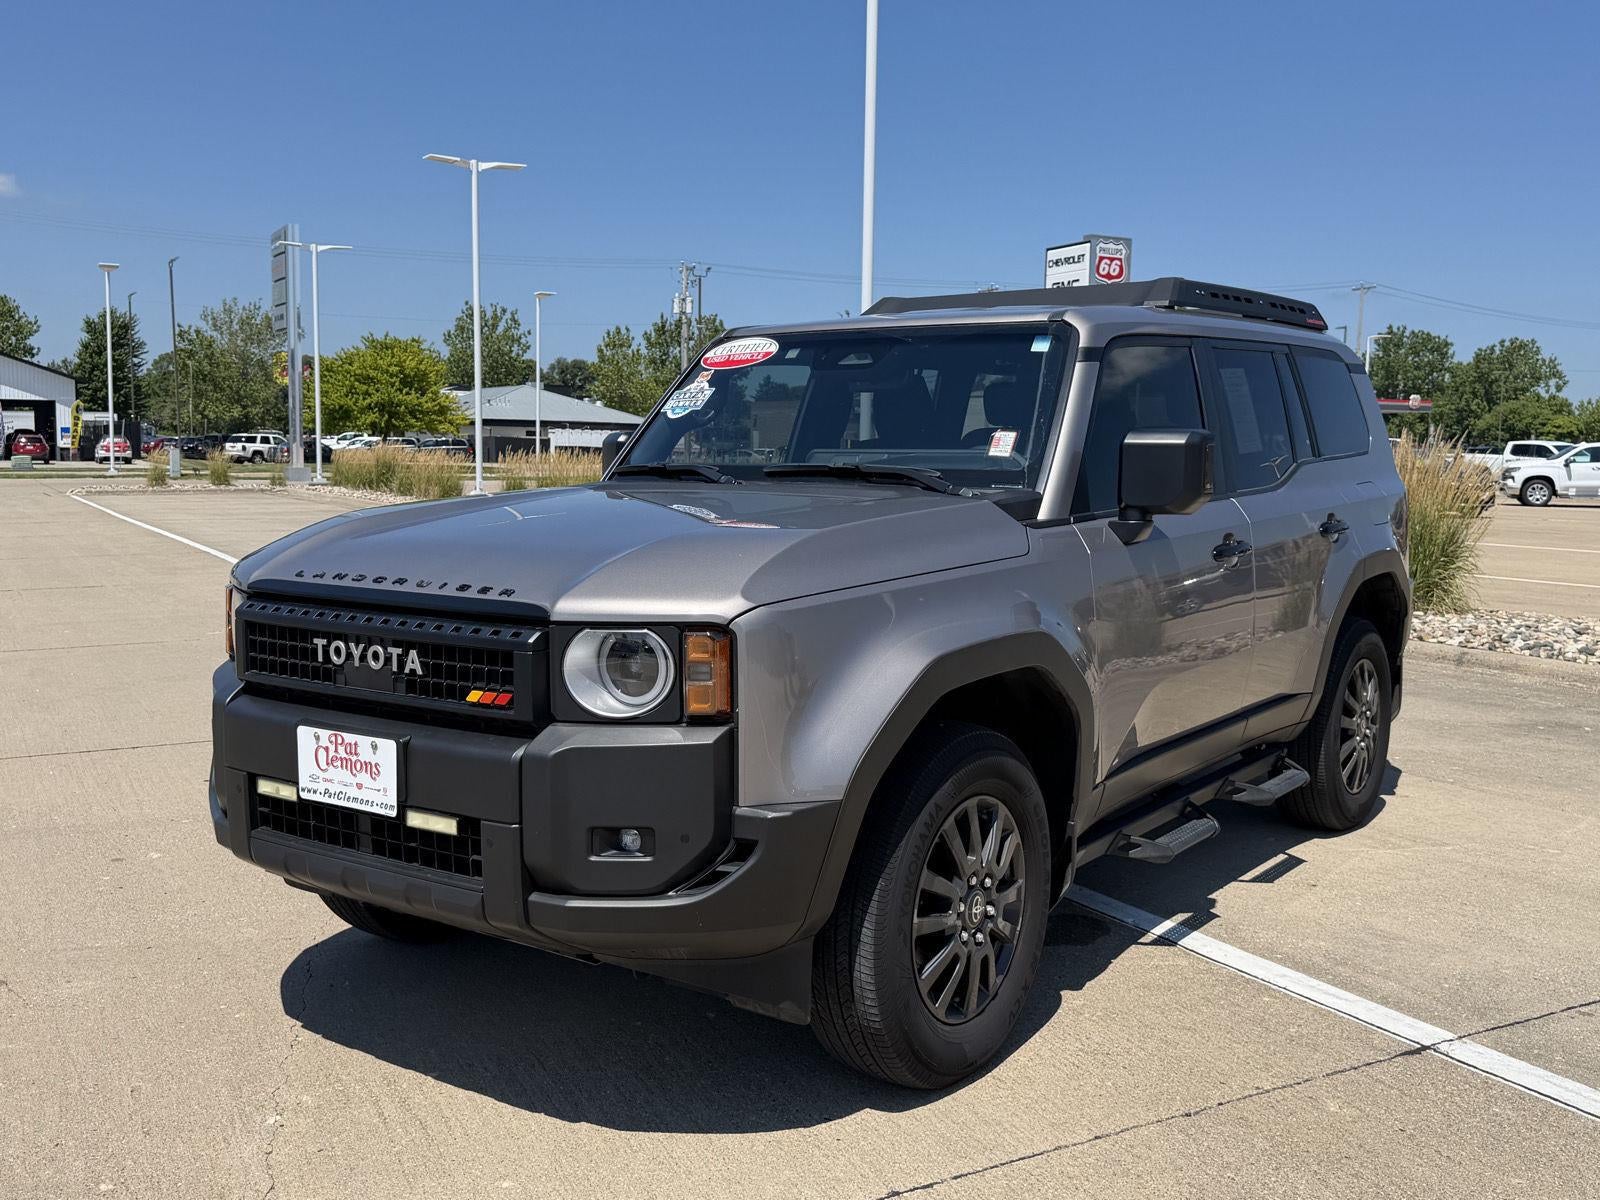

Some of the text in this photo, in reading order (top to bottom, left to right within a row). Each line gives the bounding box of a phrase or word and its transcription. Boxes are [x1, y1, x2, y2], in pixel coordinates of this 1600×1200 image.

[1099, 246, 1124, 256] PHILLIPS
[1048, 254, 1085, 268] CHEVROLET
[1098, 258, 1121, 276] 66
[707, 352, 766, 364] USED VEHICLE
[713, 342, 773, 356] CERTIFIED
[313, 638, 423, 676] TOYOTA
[328, 732, 361, 756] Pat
[314, 745, 381, 781] Clemons
[300, 785, 396, 812] www.PatClemons.com
